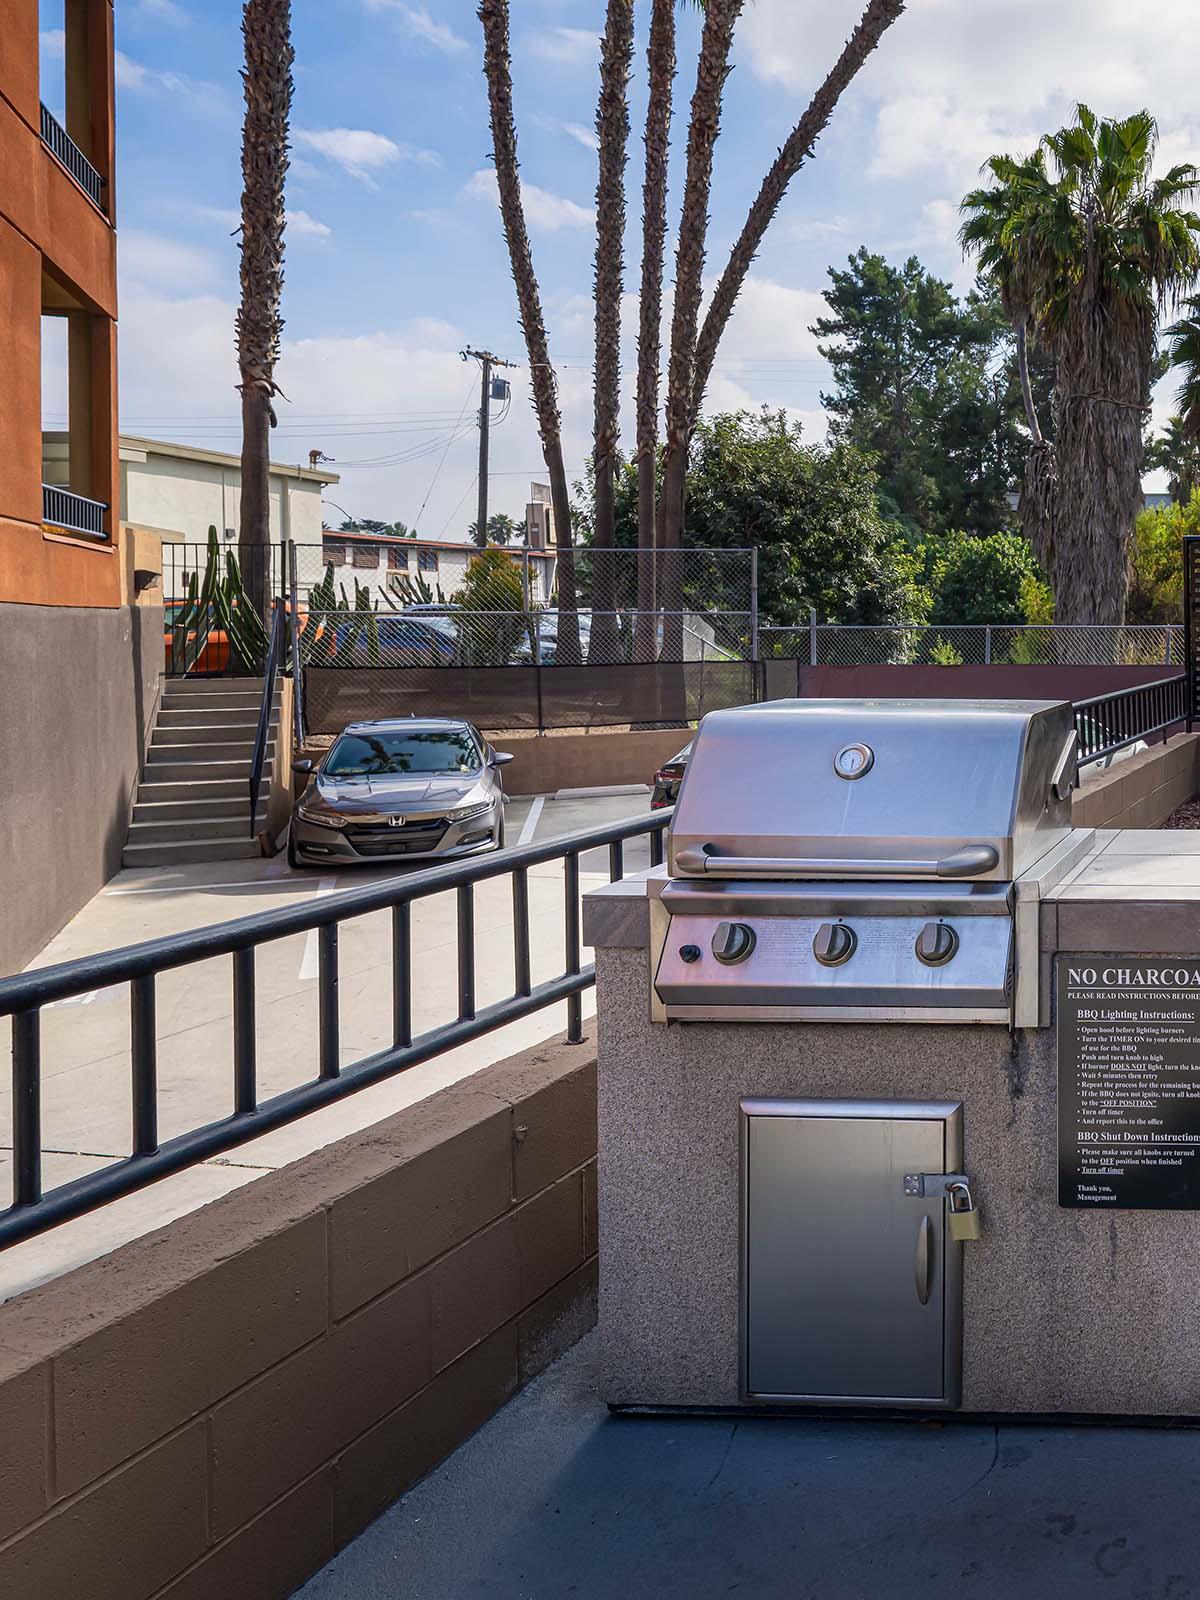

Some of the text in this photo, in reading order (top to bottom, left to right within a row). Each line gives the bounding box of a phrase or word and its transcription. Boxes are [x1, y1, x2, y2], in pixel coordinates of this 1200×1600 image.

[1067, 969, 1097, 985] NO
[1077, 1010, 1195, 1020] BBQ Lighting Instructions:
[1081, 1026, 1098, 1034] Open
[1136, 1027, 1160, 1035] lighting
[1122, 1045, 1137, 1053] BBQ
[1149, 1054, 1164, 1062] high
[1081, 1081, 1104, 1089] Repeat
[1159, 1082, 1192, 1090] remaining
[1099, 1090, 1115, 1098] BBQ
[1077, 1132, 1099, 1142] BBQ
[1100, 1132, 1122, 1141] Shut
[1123, 1132, 1149, 1141] Down
[1077, 1194, 1117, 1202] Management
